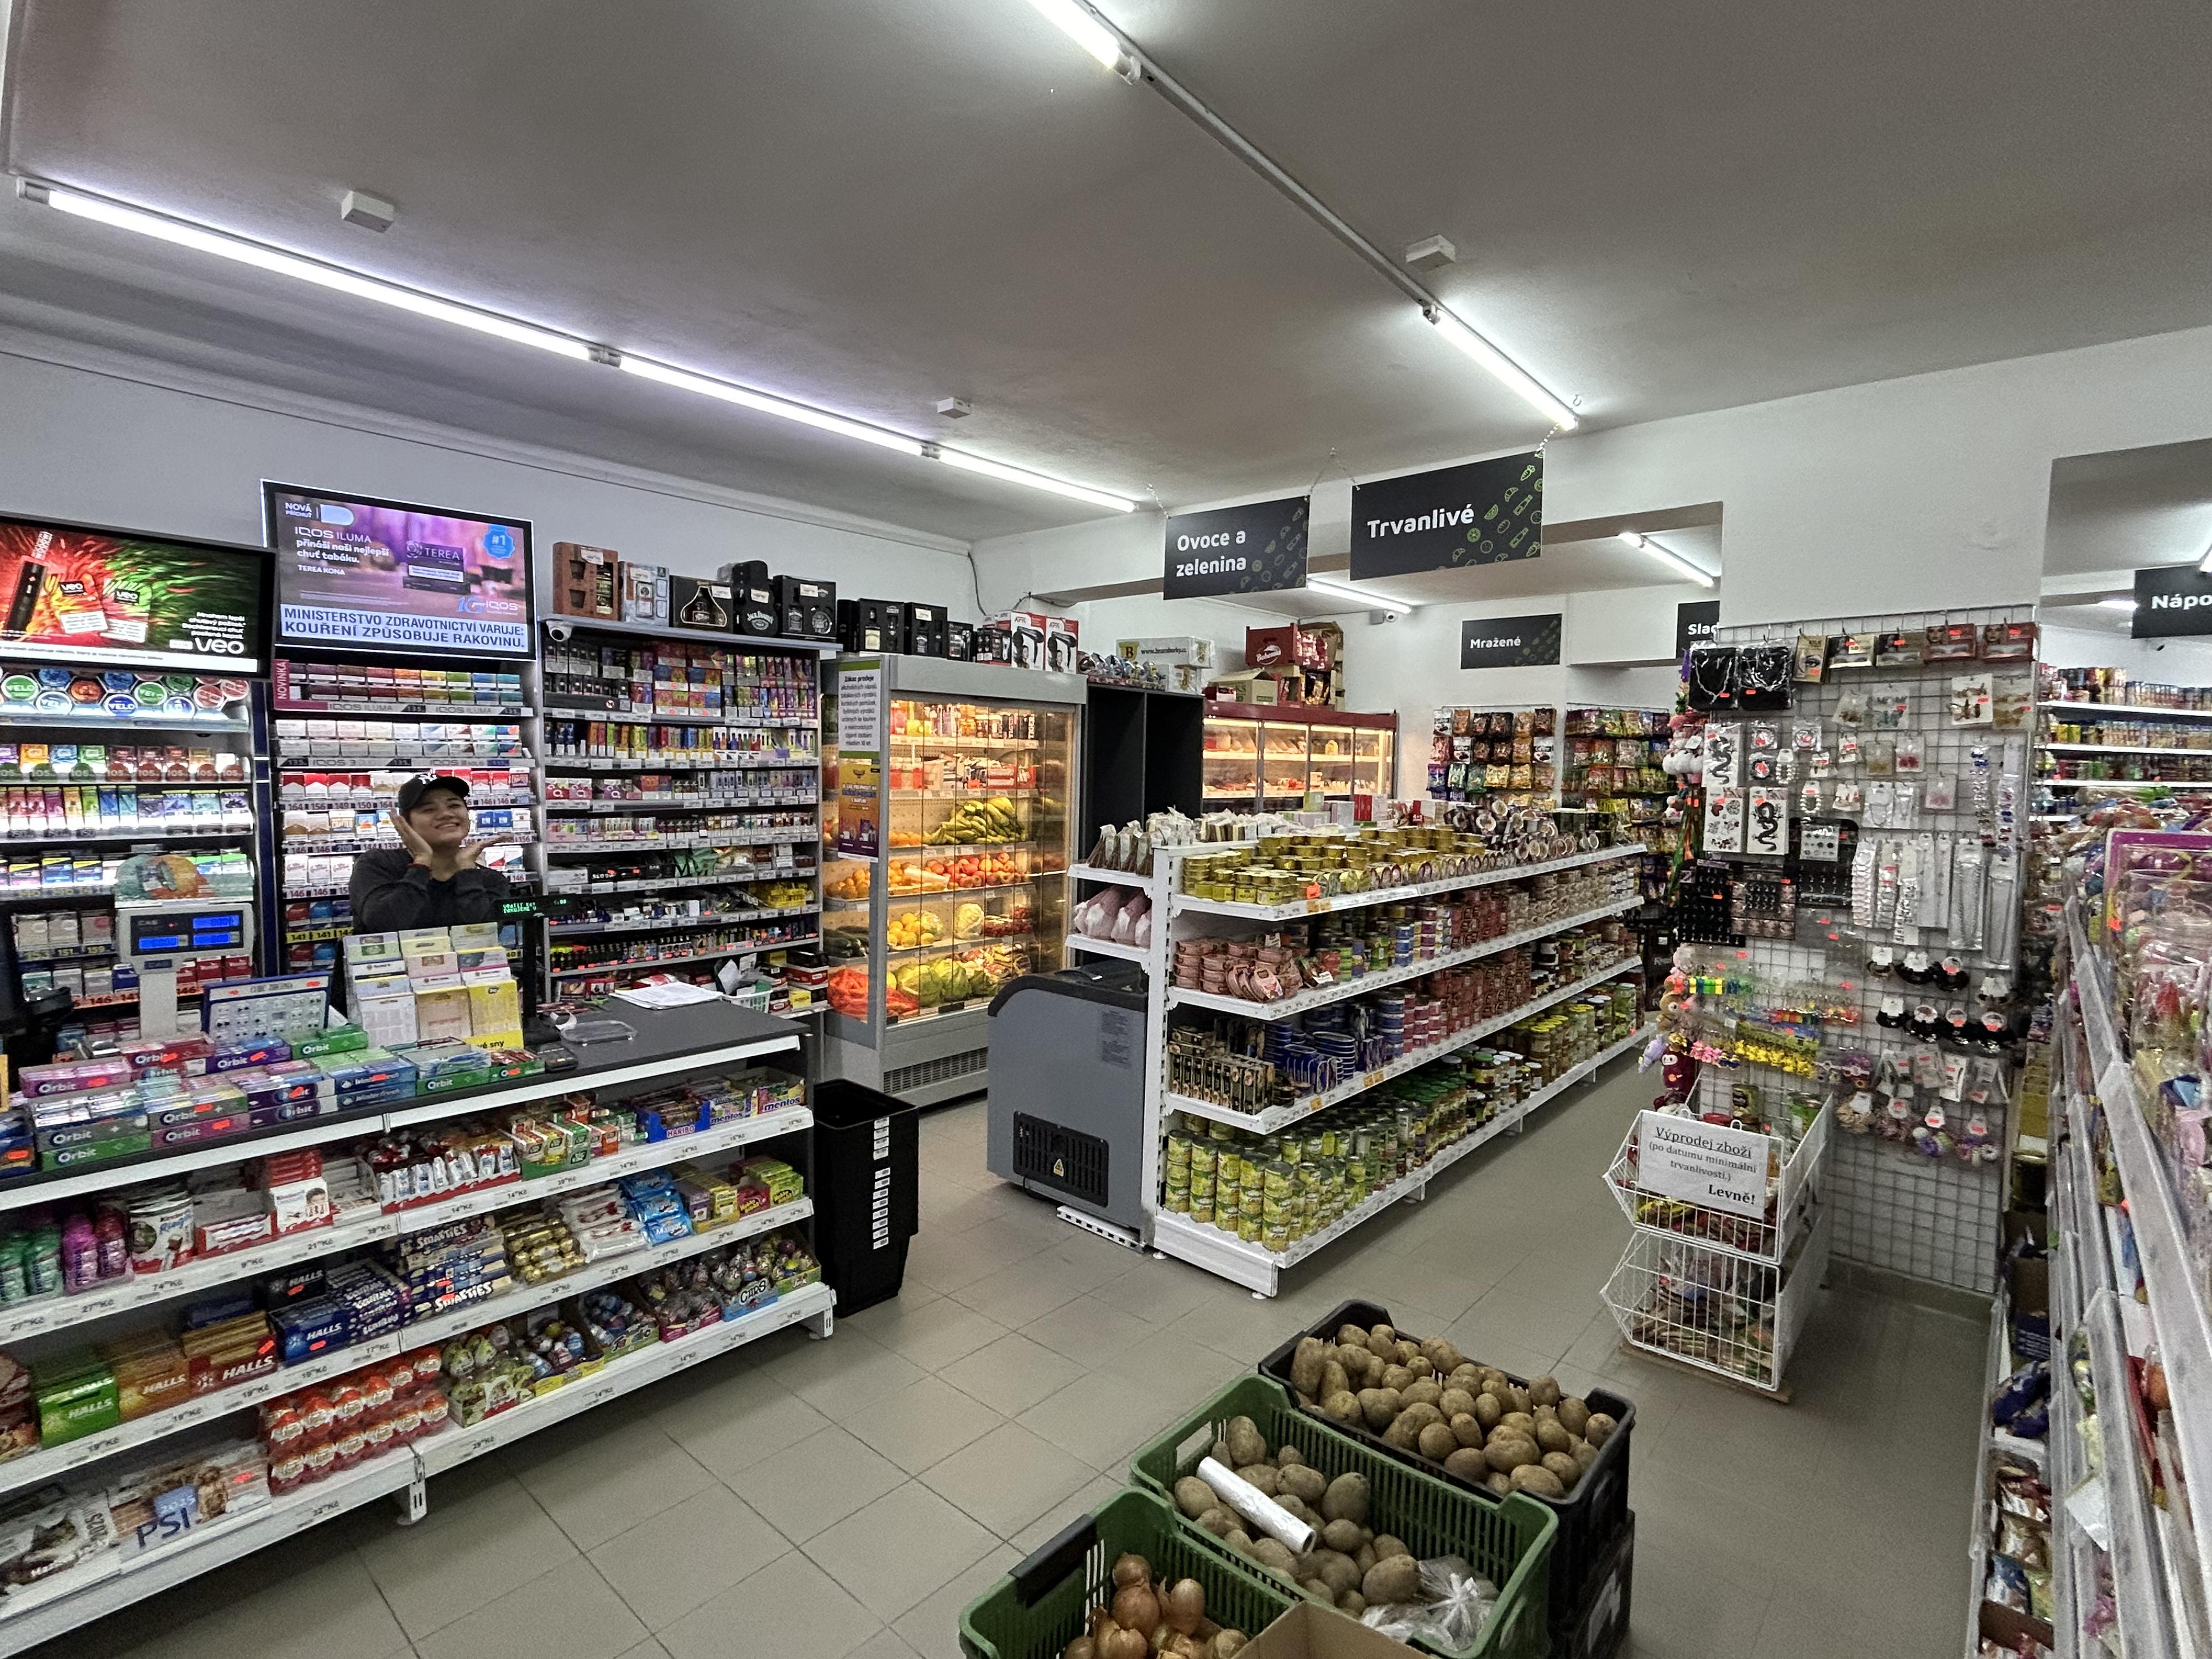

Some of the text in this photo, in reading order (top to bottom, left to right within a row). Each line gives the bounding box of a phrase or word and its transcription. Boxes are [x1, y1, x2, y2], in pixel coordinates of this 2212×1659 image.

[285, 502, 312, 513] NOVÁ
[1367, 502, 1475, 540] Trvanlivé
[294, 526, 372, 544] IQOS ILUMA
[492, 535, 506, 546] #1
[1176, 530, 1246, 552] Ovoce a
[296, 538, 389, 559] přináší naši nejlepší
[425, 547, 460, 560] TEREA
[321, 551, 360, 564] tabáku.
[298, 565, 345, 576] TEREA KONA
[1176, 555, 1247, 578] zelenina
[284, 608, 524, 636] MINISTERSTVO ZDRAVOTNICTVÍ VARUJE:
[285, 619, 525, 648] KOUŘENÍ ZPŮSOBUJE RAKOVINU.
[195, 638, 244, 654] veo
[1470, 635, 1522, 650] Mražené
[276, 661, 288, 700] NOVINKA
[291, 932, 307, 941] 141
[302, 1043, 330, 1055] Orbit
[489, 1040, 504, 1050] sny
[135, 1053, 164, 1065] Orbi
[217, 1056, 248, 1070] Orbit
[39, 1082, 77, 1093] Orbit
[427, 1078, 453, 1090] Orbit
[764, 1097, 801, 1112] mentos
[711, 1111, 743, 1125] mentos
[53, 1130, 92, 1145] Orbit
[166, 1127, 201, 1141] Orbit
[666, 1125, 696, 1139] HARIBO
[1655, 1126, 1752, 1159] Výprodej zboží
[58, 1147, 97, 1163] Orbit
[1649, 1141, 1757, 1173] (po datumu minimální
[1670, 1160, 1732, 1182] trvanlivosti.)
[1708, 1183, 1756, 1205] Levně!
[289, 1270, 324, 1286] HALLS
[306, 1322, 343, 1341] HALLS
[222, 1355, 275, 1380] HALLS
[142, 1374, 187, 1395] HALLS
[67, 1398, 114, 1420] HALLS
[136, 1507, 191, 1548] PSI
